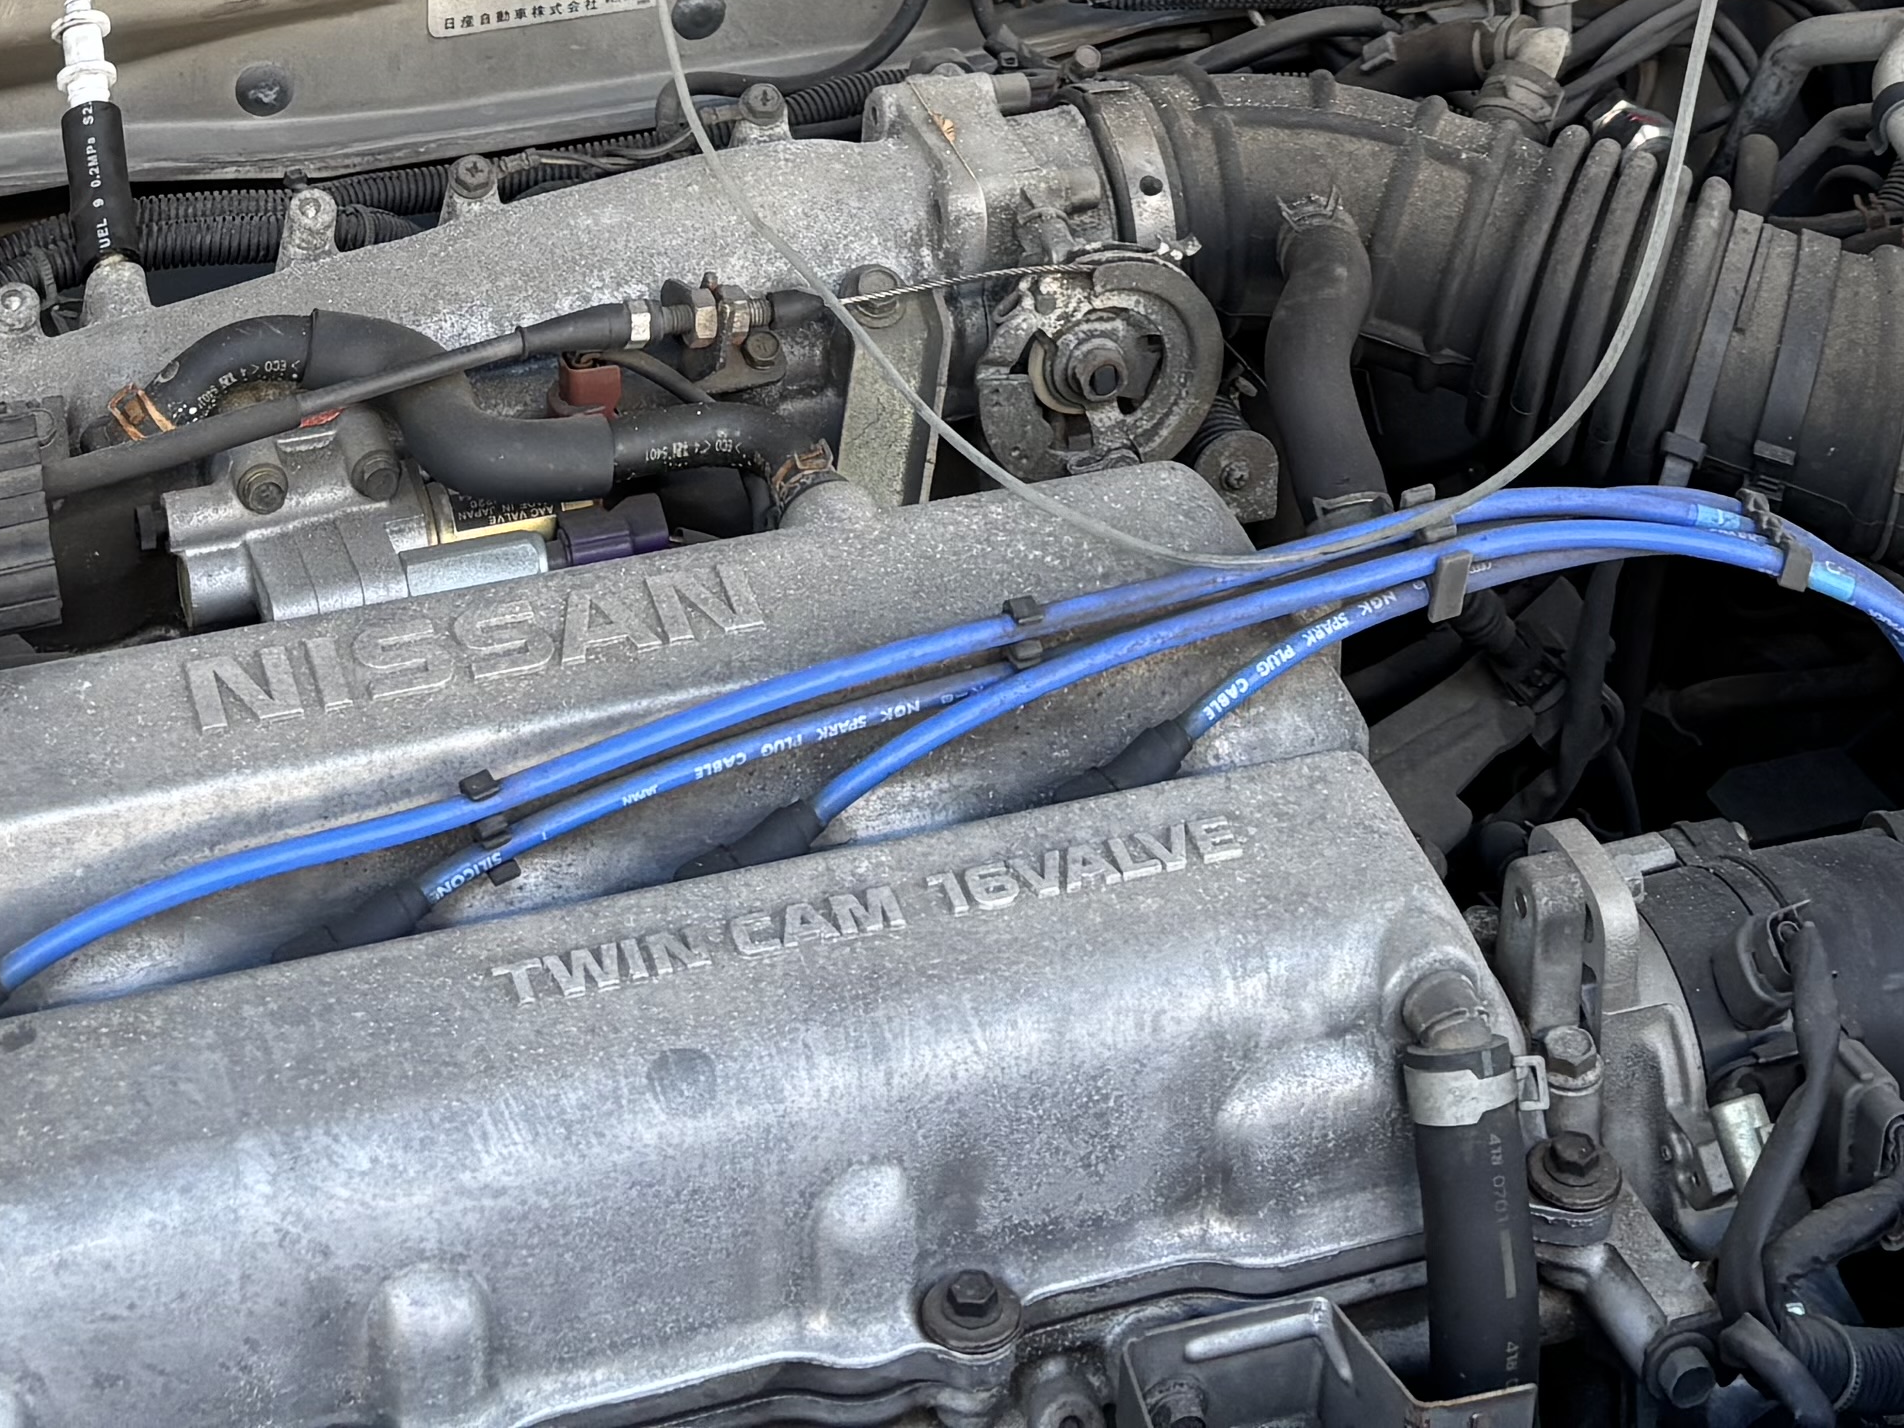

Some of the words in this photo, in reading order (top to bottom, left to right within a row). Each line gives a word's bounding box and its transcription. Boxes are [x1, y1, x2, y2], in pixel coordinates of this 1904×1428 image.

[444, 0, 598, 30] 日産自動車株式会社
[86, 136, 102, 188] 0.2MPa
[92, 198, 105, 208] 9
[98, 218, 112, 253] UEL
[457, 505, 497, 521] JAPAN
[488, 506, 528, 525] VALVE
[501, 503, 514, 512] IN
[1358, 591, 1398, 617] NGK
[1303, 611, 1351, 649] SPARK
[184, 564, 769, 736] NISSAN
[1255, 644, 1298, 681] PLUG
[880, 699, 921, 724] NGK
[1203, 677, 1252, 724] CABLE
[815, 714, 868, 741] SPARK
[760, 728, 804, 759] PLUG
[694, 752, 749, 781] CABLE
[621, 783, 659, 807] JAPAN
[492, 925, 714, 1005] TWIN
[729, 883, 909, 961] CAM
[925, 813, 1245, 917] 16VALVE
